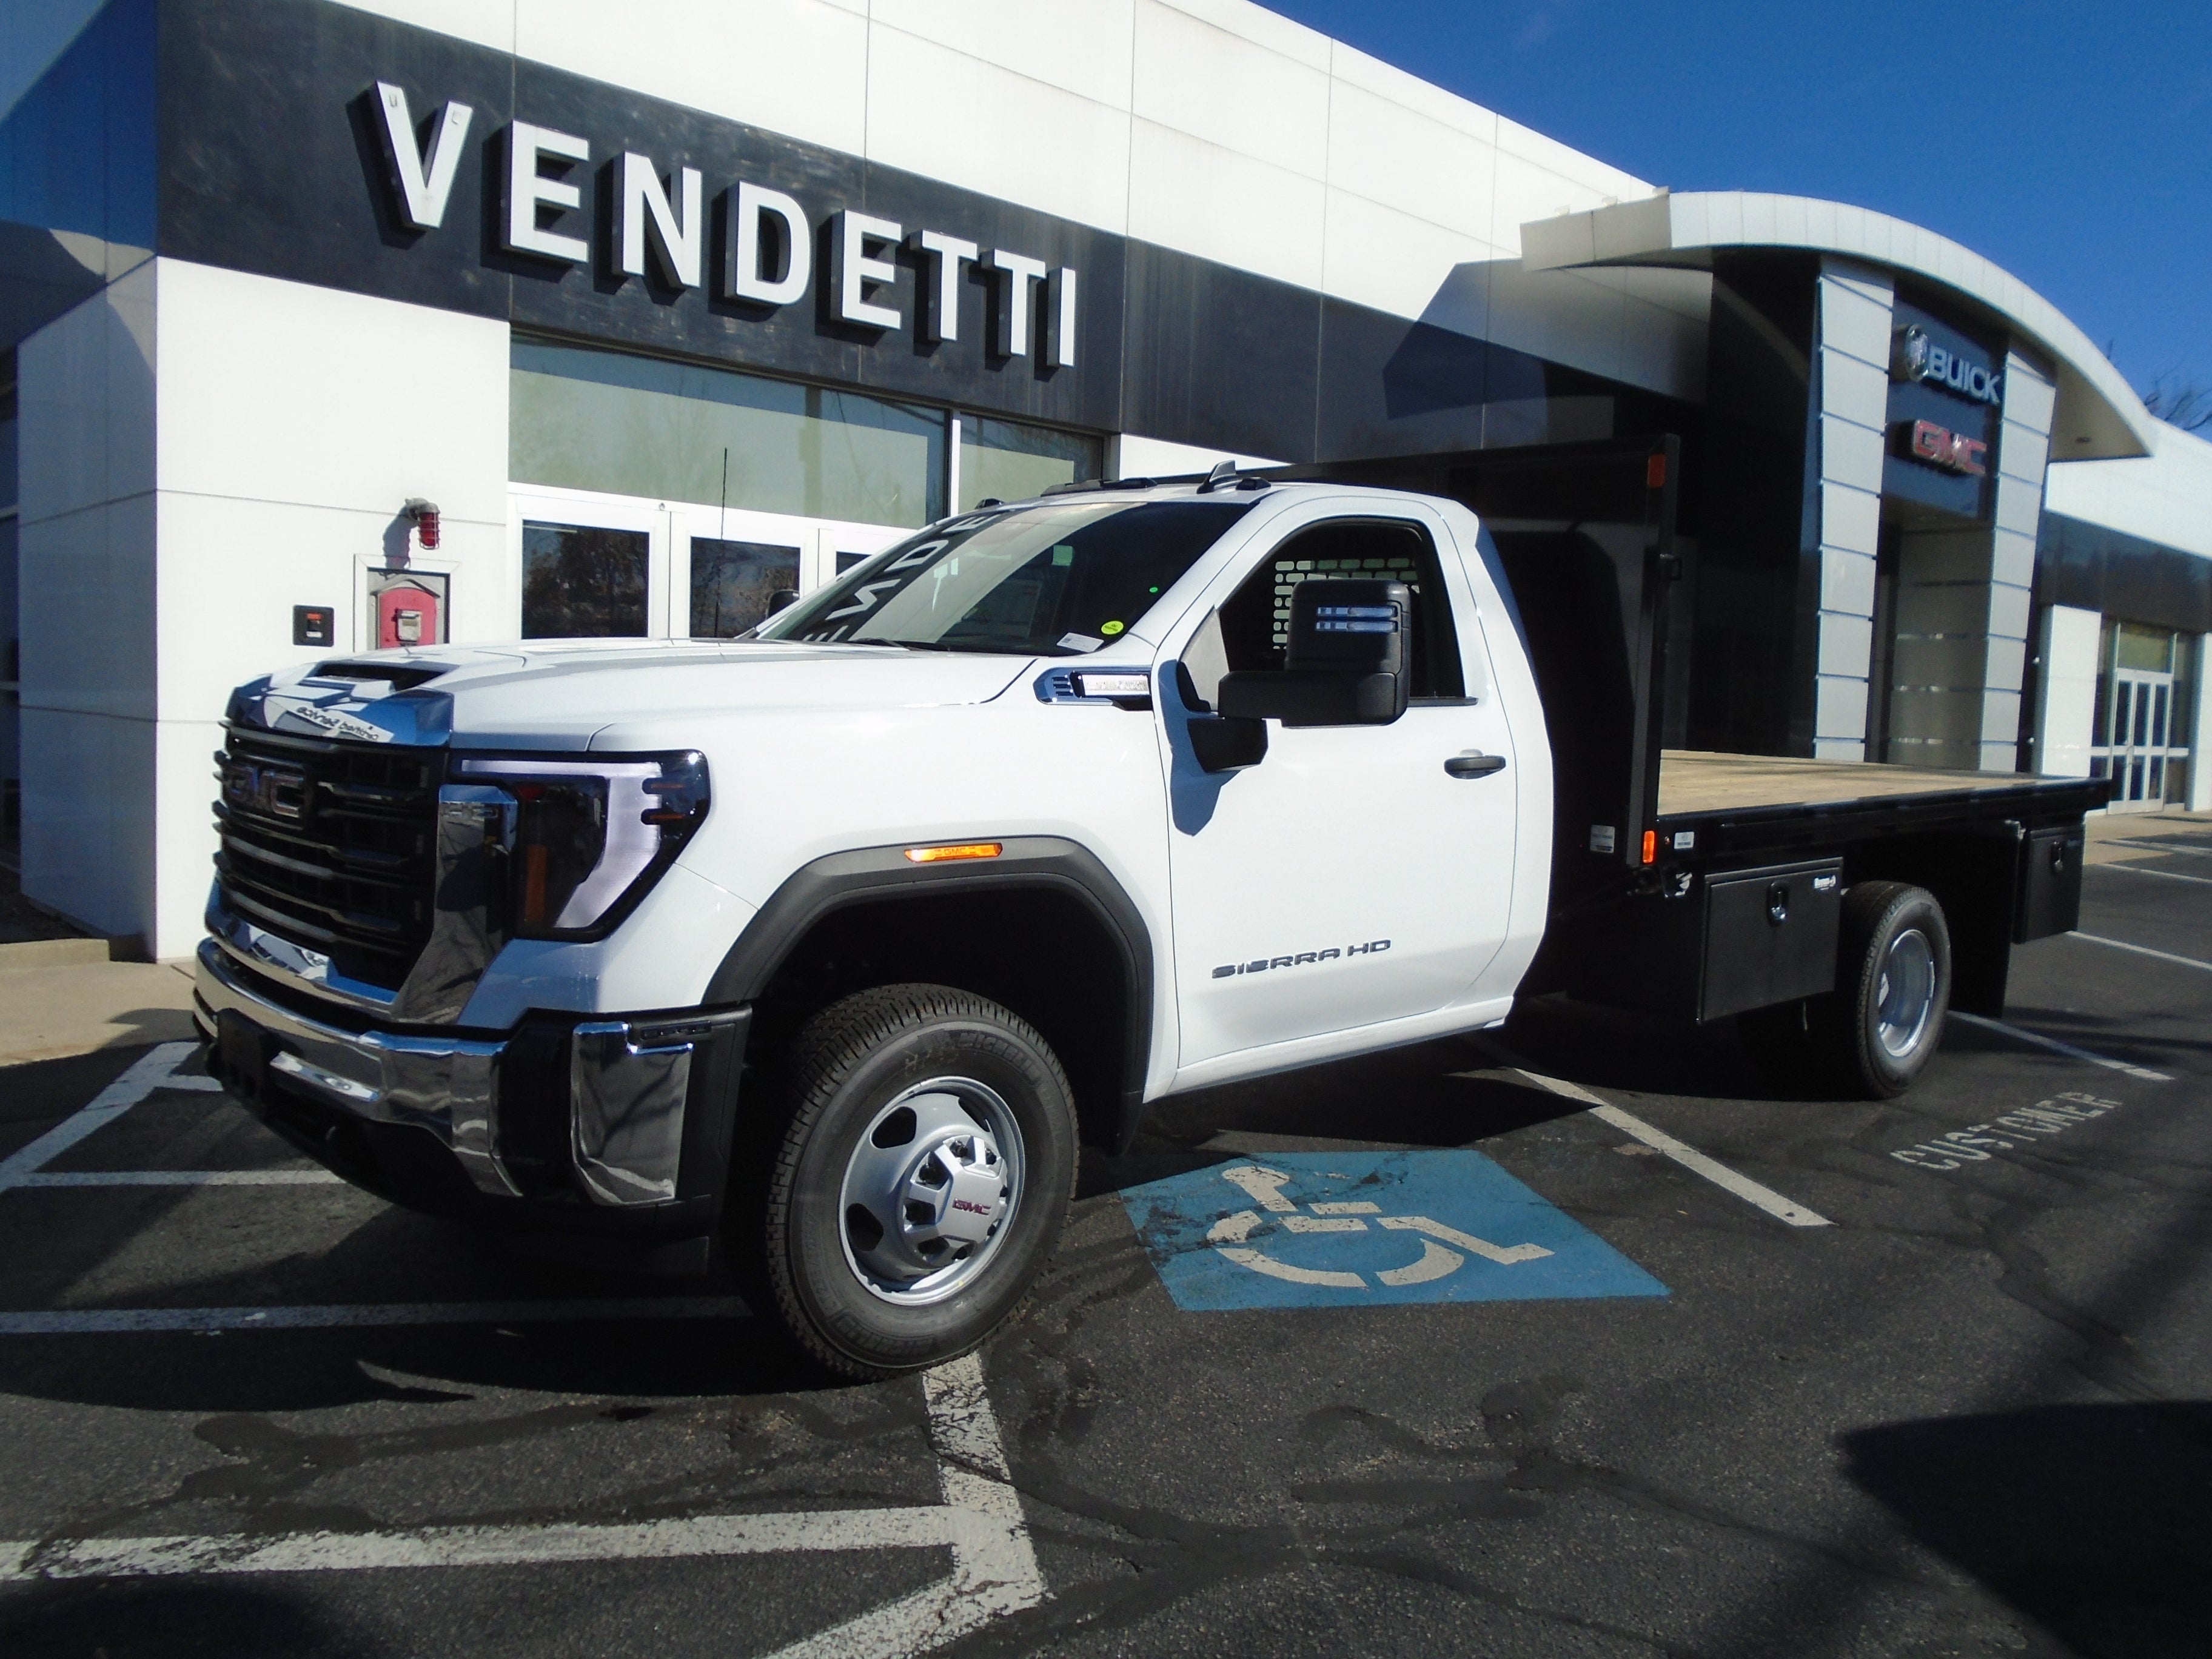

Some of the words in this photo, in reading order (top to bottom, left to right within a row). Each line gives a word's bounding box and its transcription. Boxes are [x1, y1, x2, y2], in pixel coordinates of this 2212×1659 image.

[376, 81, 1076, 368] VENDETTI
[1929, 346, 2002, 404] BUICK
[1913, 418, 1988, 475] GMC
[1212, 947, 1341, 979] SIERRA
[1347, 939, 1392, 957] HD
[1889, 1090, 2123, 1171] CUSTOMER
[952, 1198, 991, 1216] GMC
